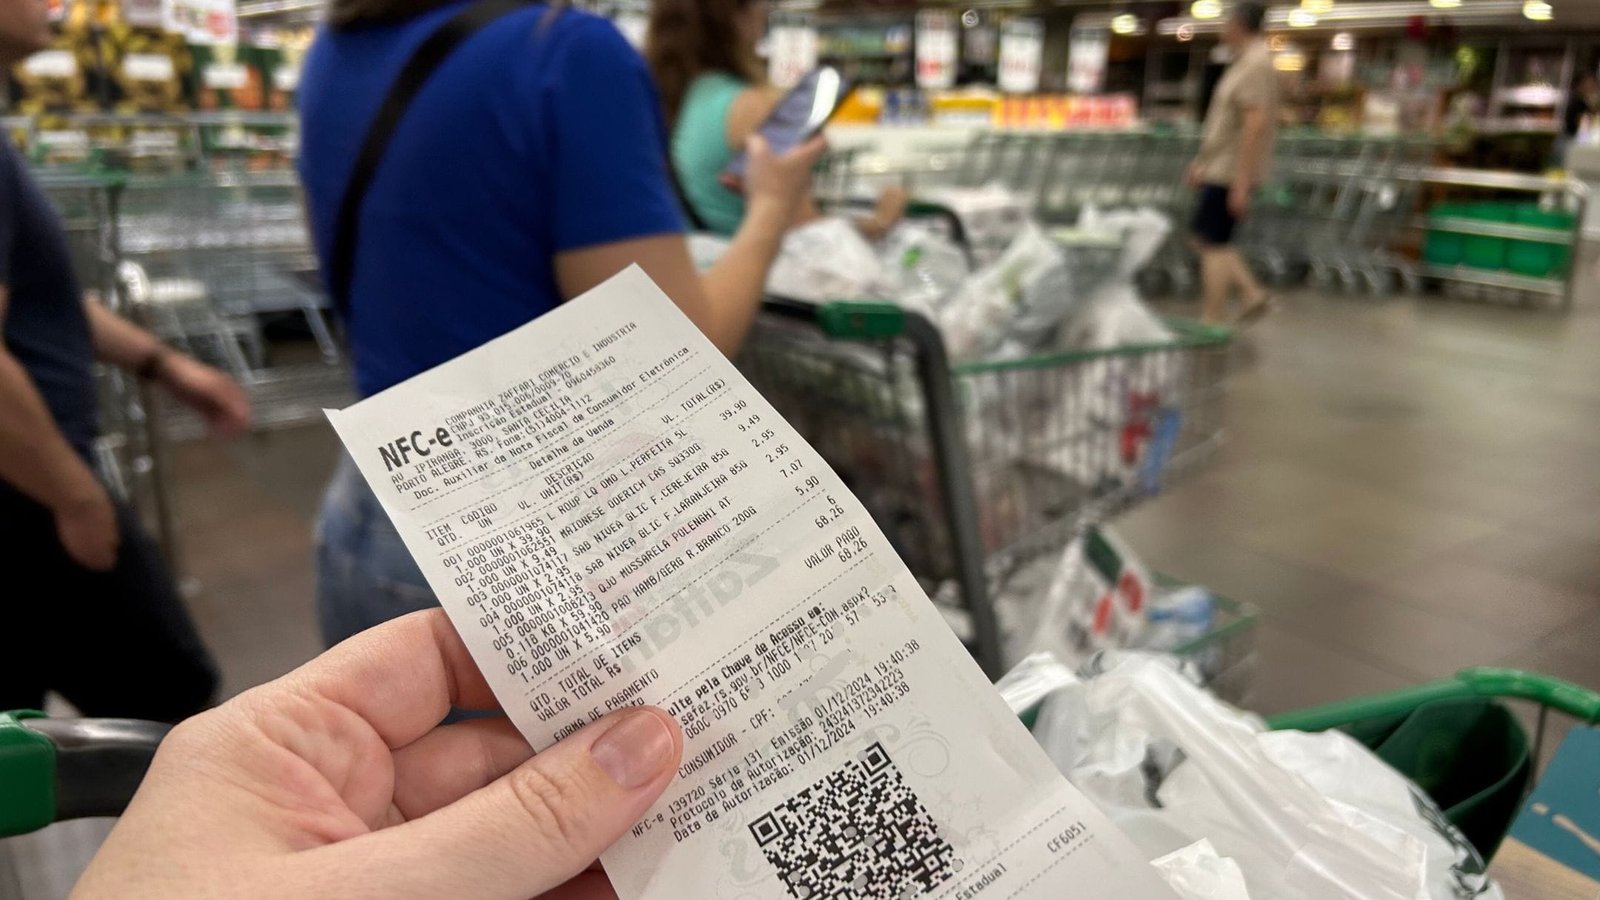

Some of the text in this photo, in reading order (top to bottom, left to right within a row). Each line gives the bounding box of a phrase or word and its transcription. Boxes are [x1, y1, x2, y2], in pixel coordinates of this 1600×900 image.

[445, 398, 495, 426] COMPANHIA
[497, 377, 535, 402] ZAFFARI
[537, 354, 580, 381] COMERCIO
[592, 320, 637, 351] INDUSTRIA
[508, 390, 552, 418] Estadual
[376, 424, 454, 472] NFC-e
[413, 345, 689, 499] Doc. Auxiliar da Nota Fiscal de Consumidor Eletrônica
[450, 417, 475, 434] CNPJ
[502, 416, 531, 436] SANTA
[529, 416, 615, 470] Detalhe da Venda
[396, 473, 427, 493] PORTO
[436, 529, 462, 547] QTD.
[477, 516, 492, 529] UN
[517, 496, 537, 511] VL.
[660, 409, 679, 425] VL.
[442, 553, 462, 568] 001
[466, 515, 544, 557] 0000001061965
[547, 510, 555, 520] L
[557, 494, 582, 514] ROUP
[599, 472, 619, 489] OMO
[619, 435, 673, 476] L.PERFEITA
[674, 427, 687, 439] 5L
[719, 398, 747, 421] 39,90
[454, 413, 761, 587] 002 0000001062551 MAIONESE ODERICH CAS SQ330G 9,49
[466, 427, 775, 606] 003 0000001074117 SAB NIVEA GLIC F.CEREJEIRA 85G 2,95
[425, 522, 451, 540] ITEM
[455, 553, 487, 574] 1.000
[490, 545, 505, 558] UN
[479, 442, 789, 628] 004 0000001074118 SAB NIVEA GLIC F.LARANJEIRA 85G 2,95
[492, 632, 514, 651] 005
[618, 538, 670, 578] MUSSARELA
[671, 506, 717, 542] POLENGHI
[718, 495, 731, 509] AT
[779, 458, 803, 479] 7,07
[837, 536, 868, 563] 68,26
[467, 571, 499, 593] 1.000
[502, 563, 517, 577] UN
[479, 590, 511, 613] 1.000
[514, 582, 530, 596] UN
[506, 655, 528, 675] 006
[530, 609, 610, 660] 0000001041420
[632, 556, 684, 597] HAMB/GERG
[685, 522, 731, 559] R.BRANCO
[731, 504, 757, 527] 200G
[794, 474, 819, 496] 5,90
[528, 493, 836, 712] QTD. TOTAL DE ITENS 6
[537, 503, 844, 723] VALOR TOTAL R$ 68,26
[493, 610, 525, 635] 1.000
[527, 601, 543, 616] UN
[505, 632, 538, 660] 0.118
[540, 622, 557, 638] KG
[552, 716, 585, 742] FORMA
[587, 705, 603, 721] DE
[604, 667, 659, 710] PAGAMENTO
[803, 543, 834, 569] VALOR
[835, 525, 860, 548] PAGO
[520, 656, 553, 683] 1.000
[554, 645, 571, 661] UN
[572, 638, 582, 650] X
[666, 693, 693, 717] ulte
[693, 674, 720, 699] pela
[720, 651, 752, 679] Chave
[752, 639, 768, 656] de
[768, 614, 806, 646] Acesso
[767, 658, 791, 681] 1000
[631, 811, 664, 838] NFC-e
[667, 784, 706, 814] 139720
[707, 762, 741, 789] Série
[743, 748, 762, 766] 131
[813, 671, 872, 719] 01/12/2024
[872, 637, 920, 677] 19:40:38
[669, 786, 727, 828] Protocolo
[727, 775, 744, 792] de
[745, 729, 817, 781] Autorização:
[818, 667, 904, 733] 243241372342223
[673, 679, 910, 842] Data de Autorização: 01/12/2024 19:40:38
[677, 705, 775, 779] CONSUMIDOR CPF:
[954, 819, 1087, 900] Estadual CF6051
